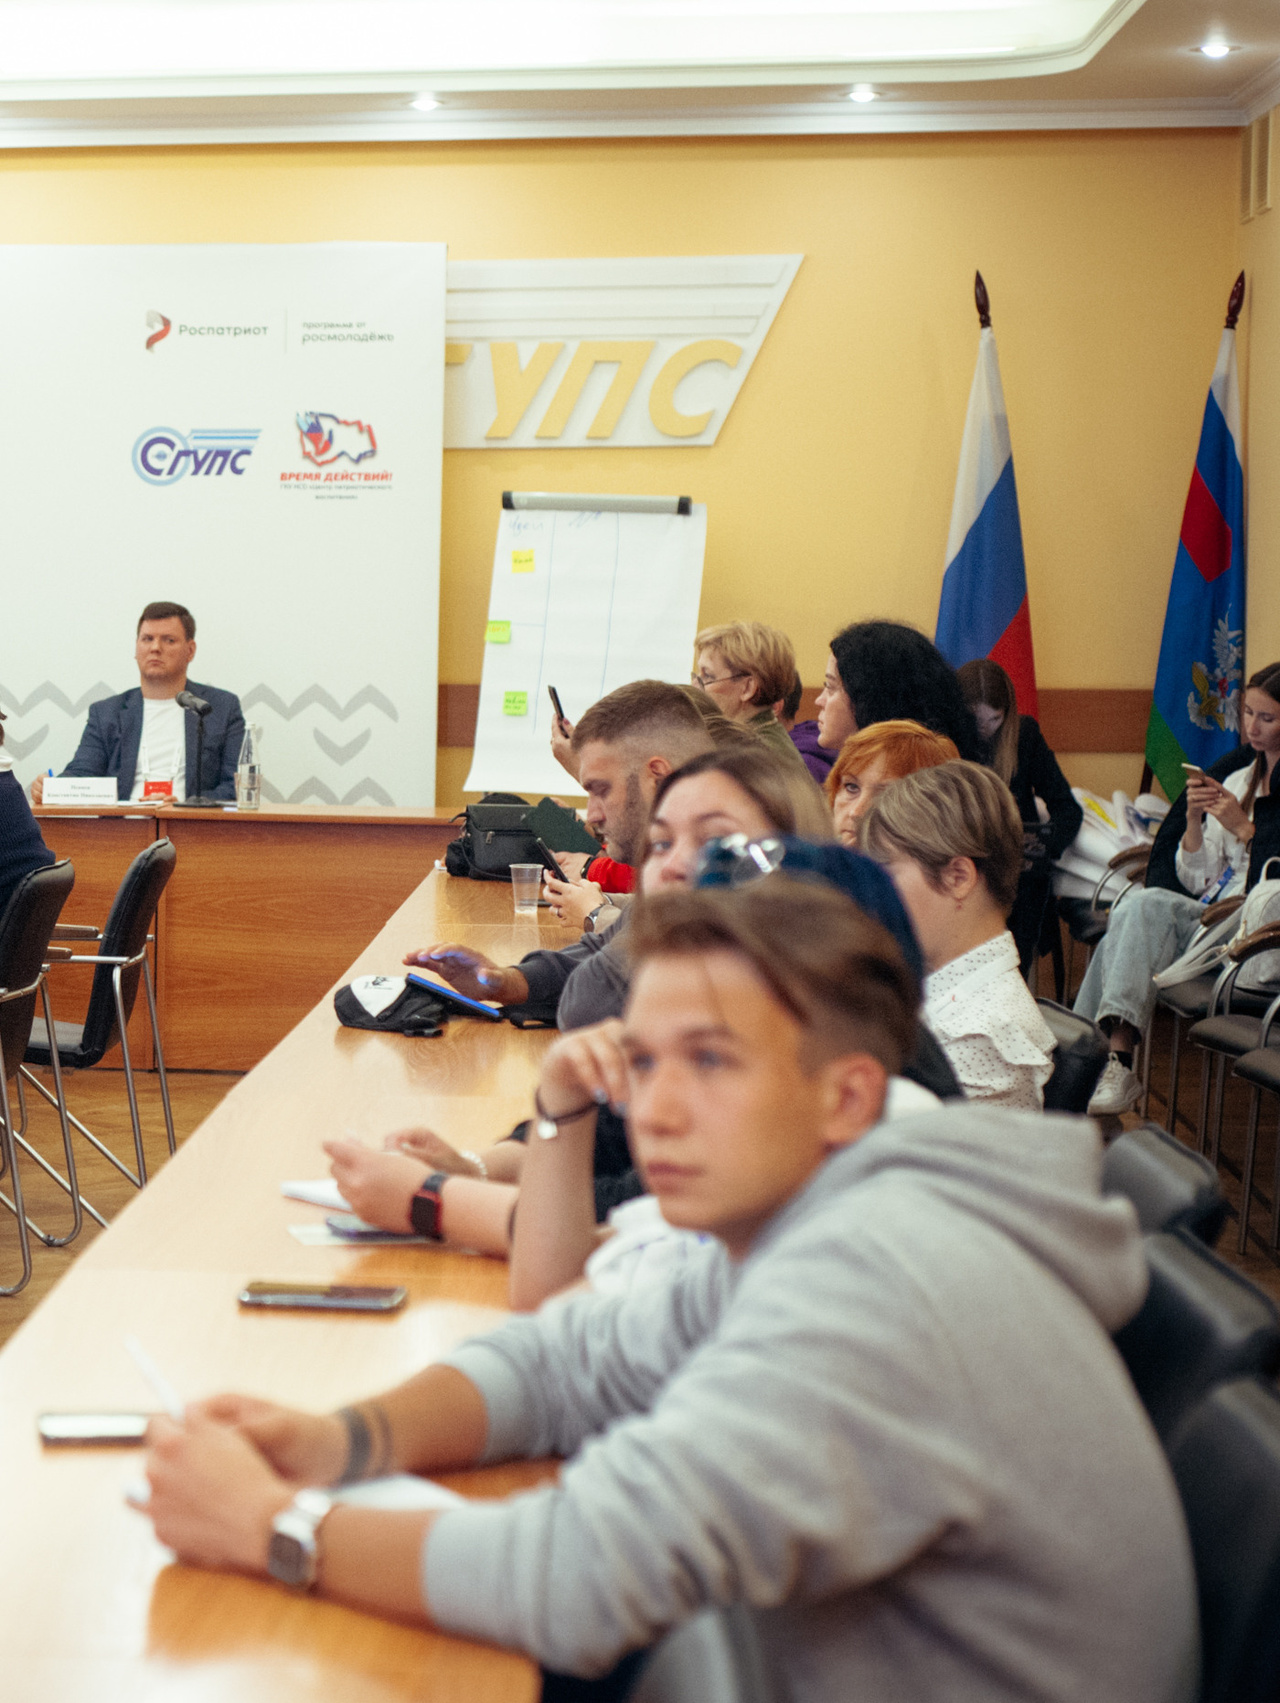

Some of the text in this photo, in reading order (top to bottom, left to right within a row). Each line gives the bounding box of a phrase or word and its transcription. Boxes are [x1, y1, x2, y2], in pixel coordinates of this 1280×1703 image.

[178, 324, 268, 338] Роспатриот
[302, 332, 395, 346] росмолодёжь
[445, 341, 743, 440] УПС
[280, 470, 393, 483] ВРЕМЯ ДЕЙСТВИЙ!
